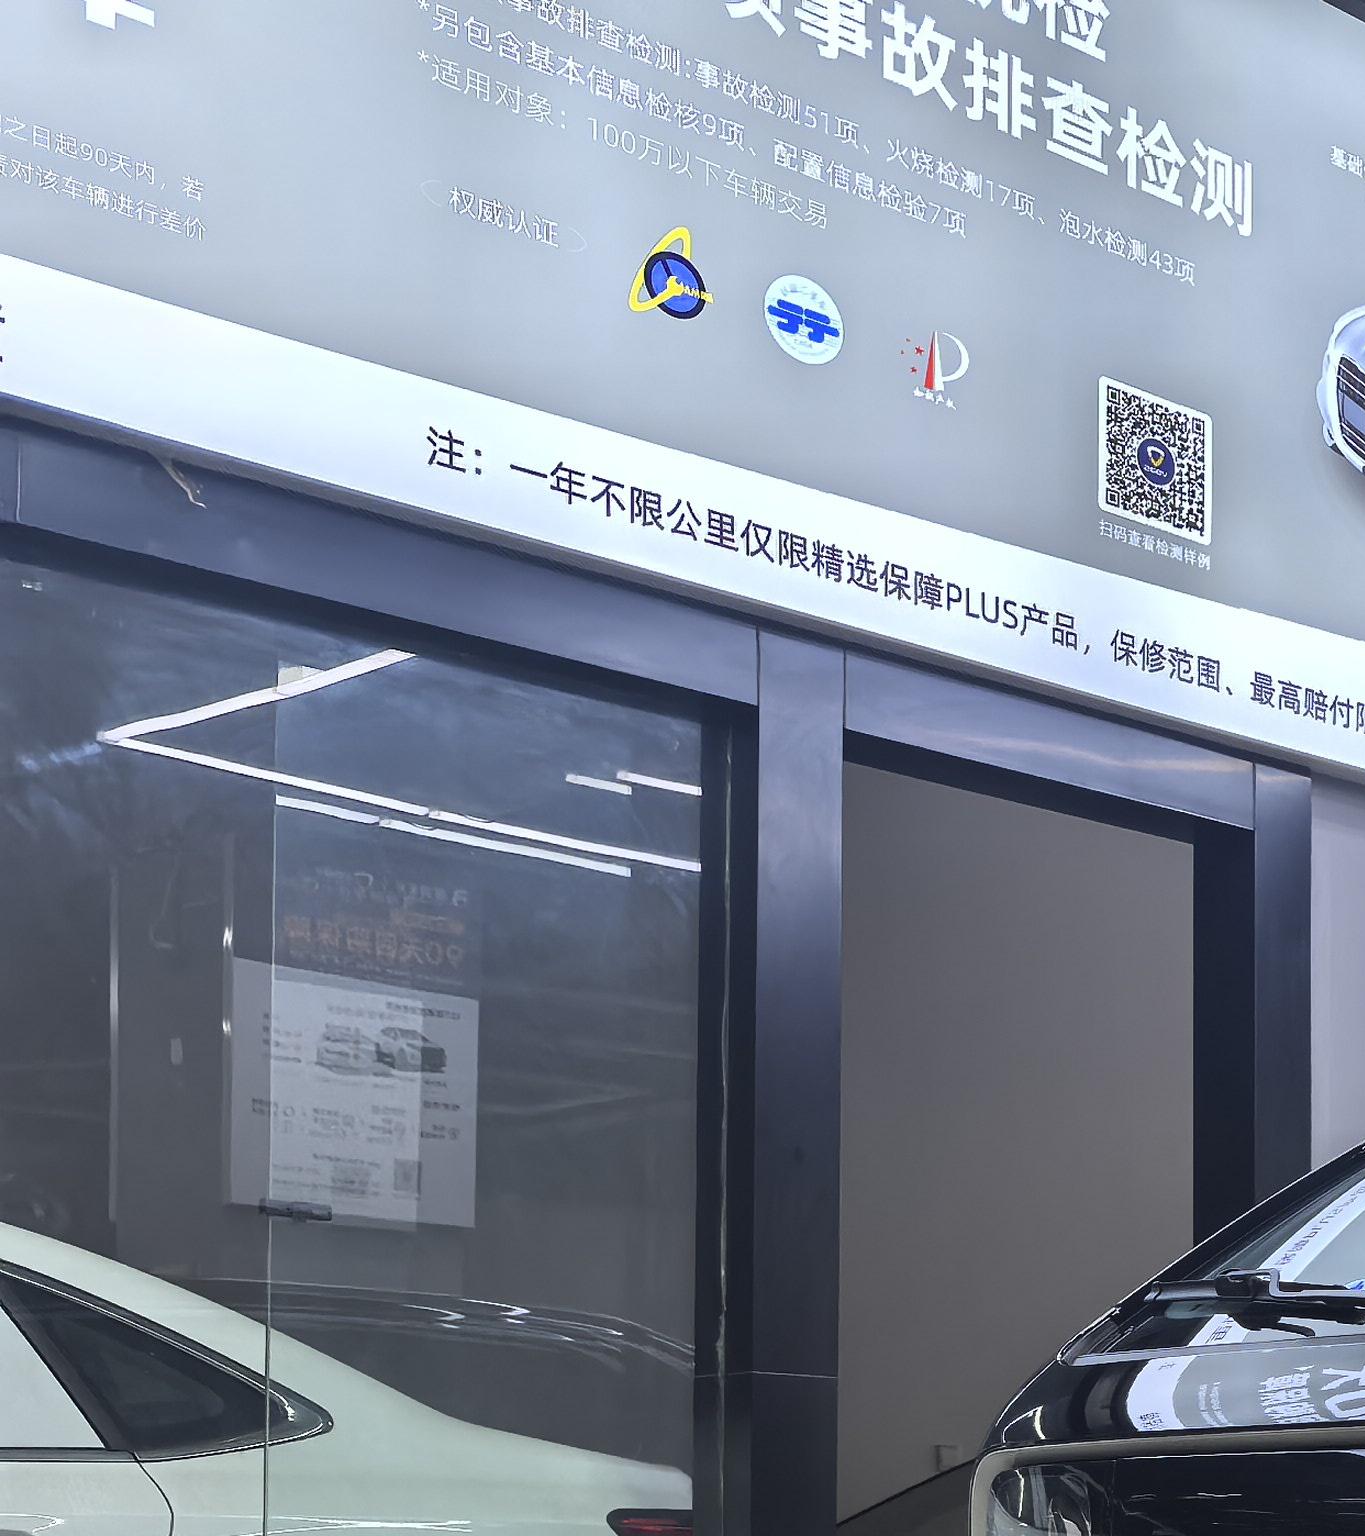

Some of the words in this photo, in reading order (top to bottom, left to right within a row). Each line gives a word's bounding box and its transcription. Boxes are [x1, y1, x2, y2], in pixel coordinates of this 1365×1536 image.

[0, 113, 204, 202] 之日起90天内，若
[448, 186, 560, 249] 权威认证
